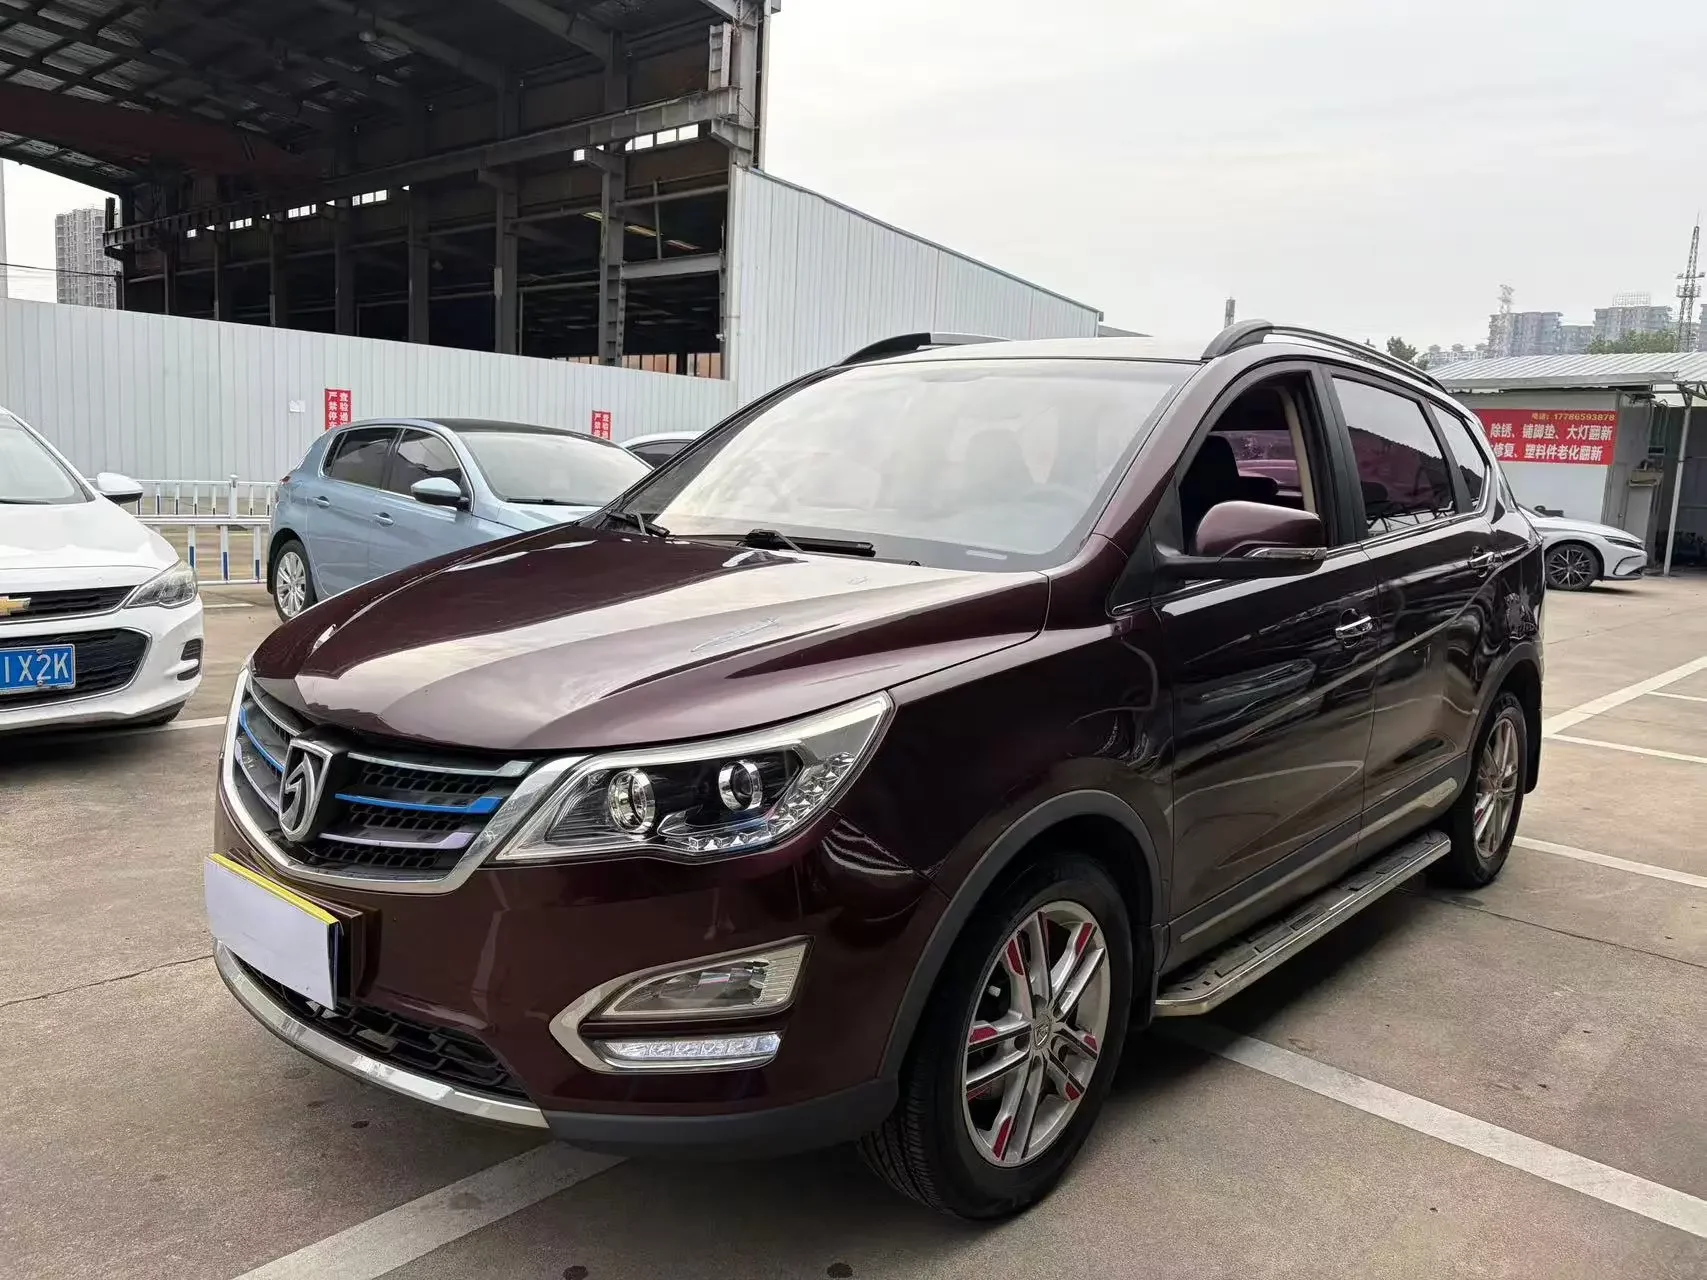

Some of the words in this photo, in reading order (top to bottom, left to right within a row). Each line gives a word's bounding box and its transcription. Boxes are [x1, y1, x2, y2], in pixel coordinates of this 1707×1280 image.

[1490, 442, 1603, 461] 修复、塑料件老化翻新
